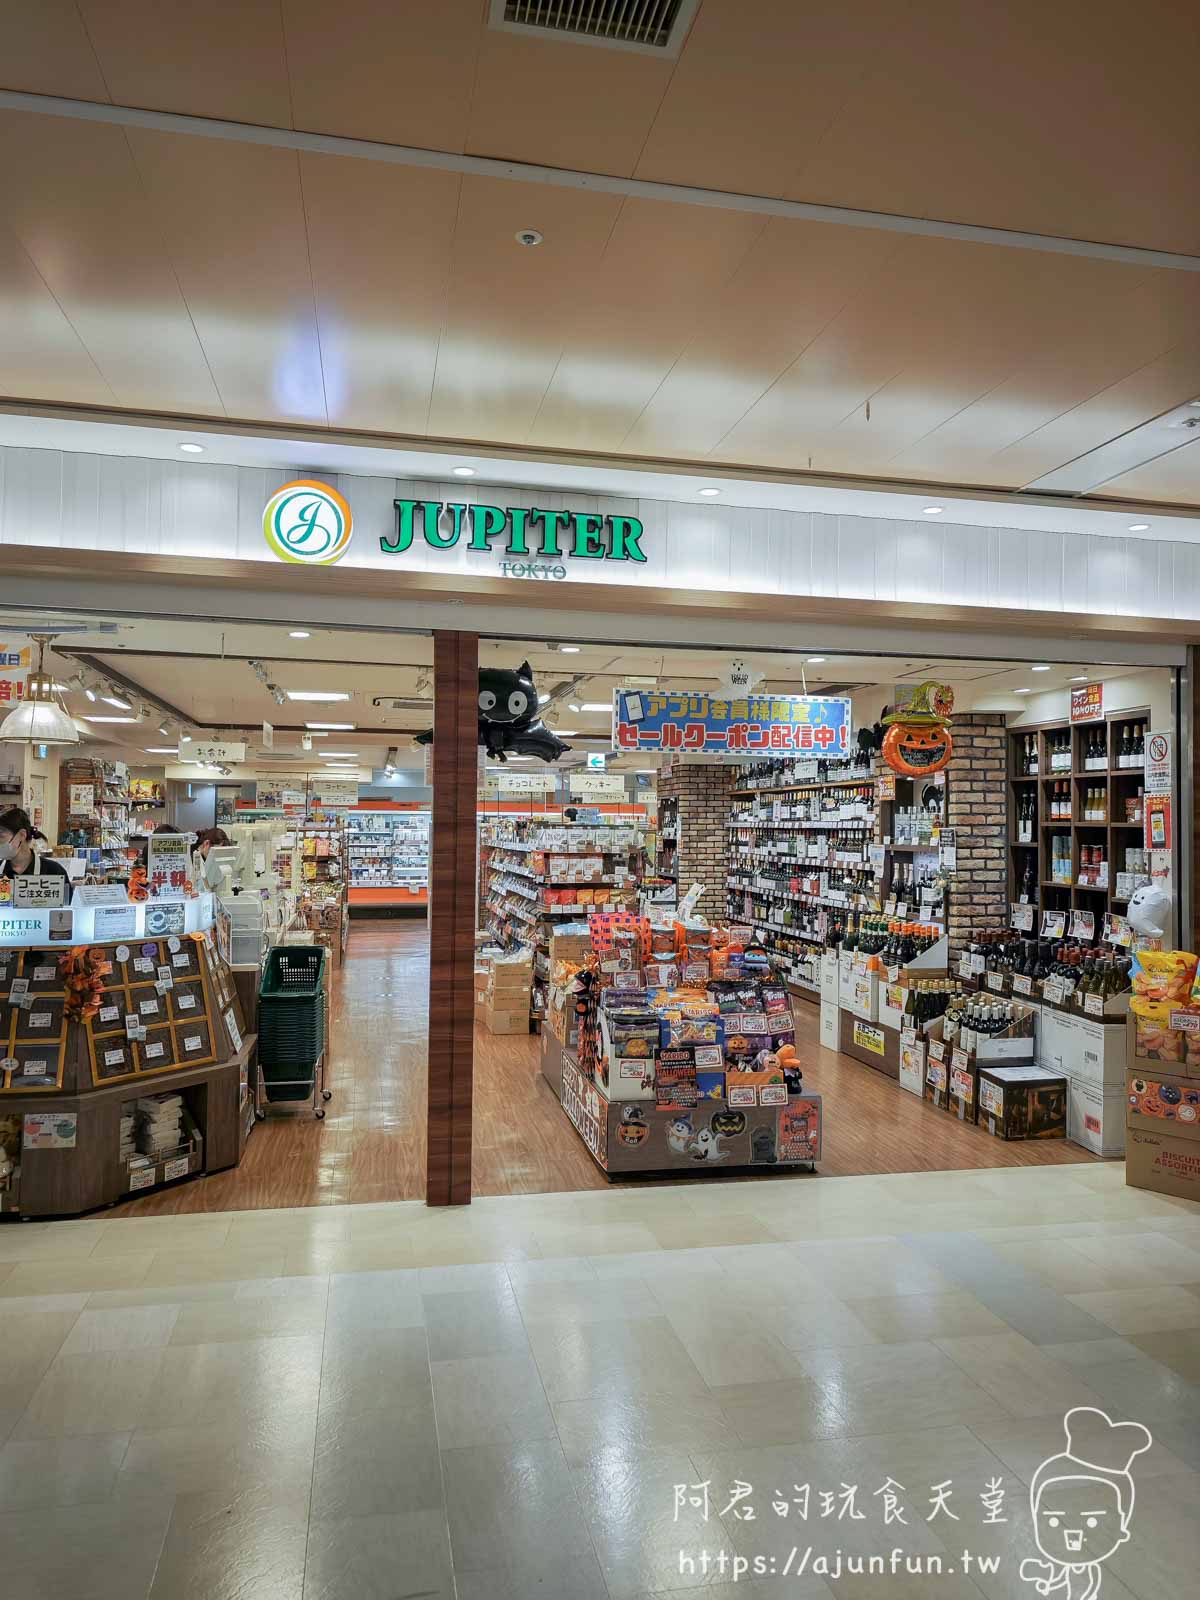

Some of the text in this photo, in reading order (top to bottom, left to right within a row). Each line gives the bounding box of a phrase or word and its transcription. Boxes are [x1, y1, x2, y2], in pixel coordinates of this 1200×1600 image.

[379, 498, 648, 563] JUPITER
[499, 562, 567, 581] TOKYO
[617, 722, 848, 750] セールクーポン配信中!
[508, 779, 549, 787] チョコレート
[585, 780, 611, 788] クッキー
[18, 879, 60, 889] コーヒー
[19, 889, 60, 899] ご注文受付
[661, 1051, 690, 1060] HARIBO
